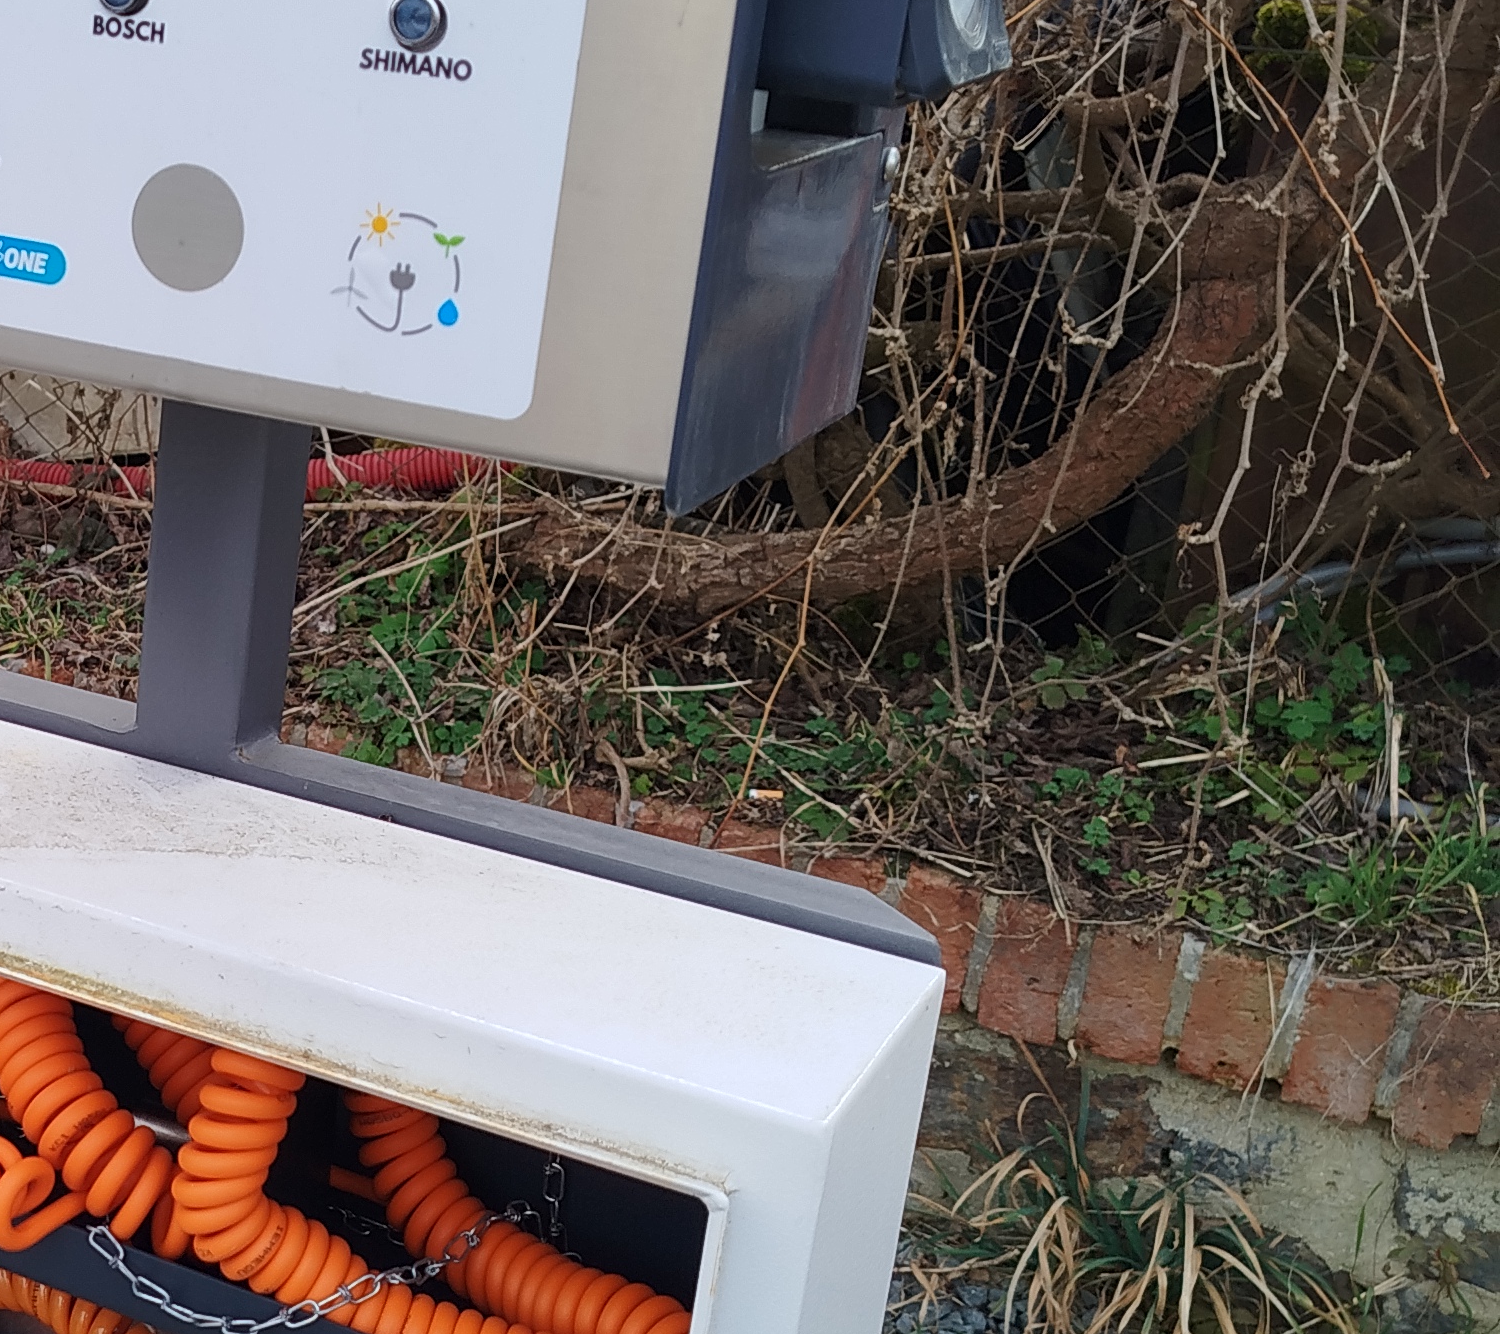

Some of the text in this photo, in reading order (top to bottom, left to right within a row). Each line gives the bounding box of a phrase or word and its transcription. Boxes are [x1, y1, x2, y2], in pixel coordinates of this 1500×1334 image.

[92, 14, 166, 44] BOSCH
[358, 47, 473, 82] SHIMANO
[3, 247, 49, 275] ONE
